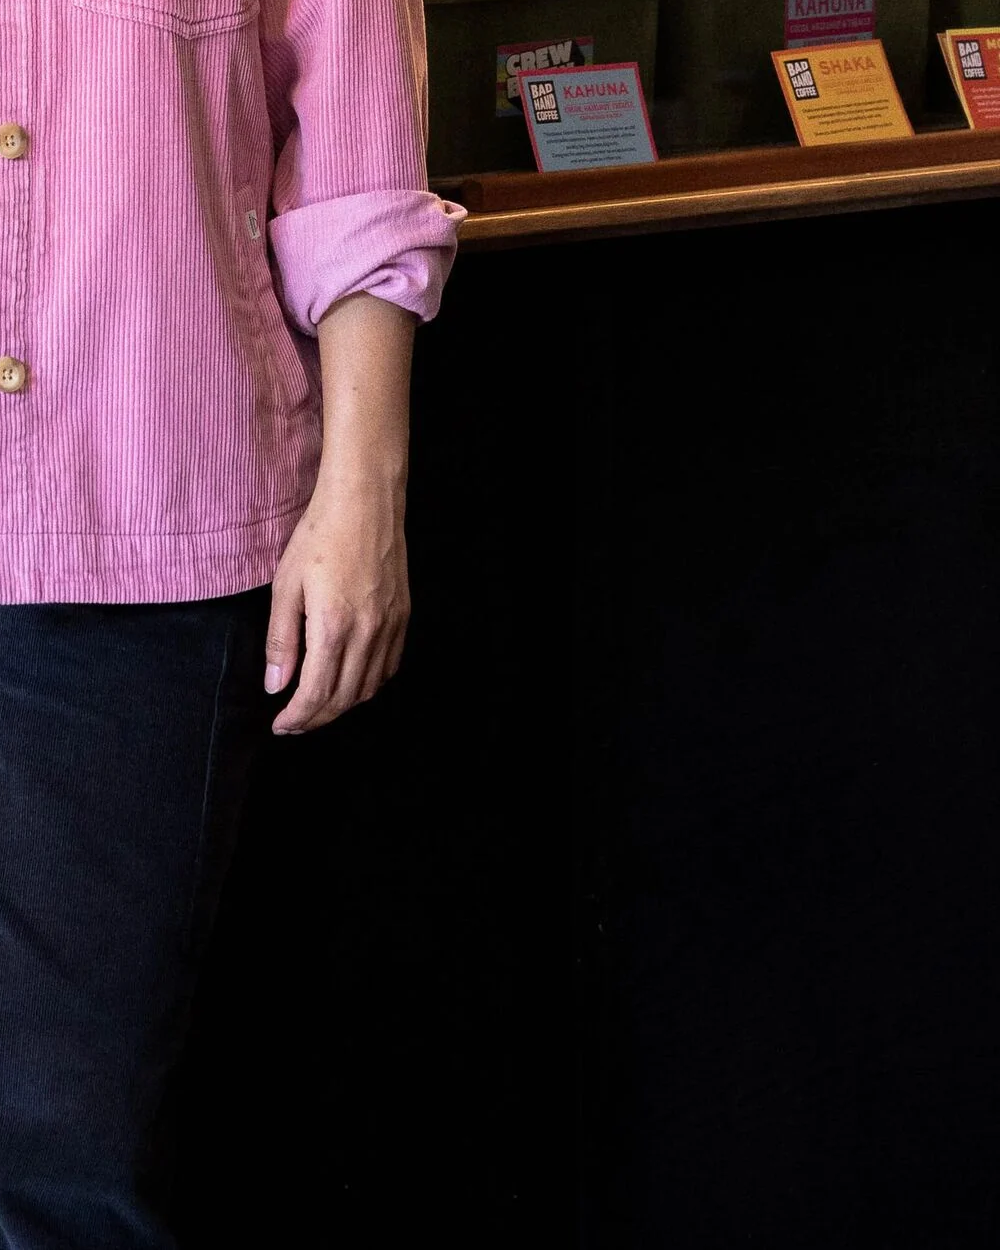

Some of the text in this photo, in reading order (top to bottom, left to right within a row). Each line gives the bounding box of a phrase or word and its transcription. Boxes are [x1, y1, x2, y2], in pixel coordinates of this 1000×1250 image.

[958, 41, 979, 57] BAD
[506, 40, 573, 76] CREW
[818, 55, 877, 76] SHAKA
[960, 52, 983, 69] HAND
[786, 60, 809, 77] BAD
[963, 67, 986, 79] COFFEE
[791, 71, 814, 89] HAND
[530, 83, 553, 99] BAD
[563, 81, 630, 100] KAHUNA
[795, 86, 818, 99] COFFEE
[533, 93, 557, 112] HAND
[536, 109, 559, 122] COFFEE
